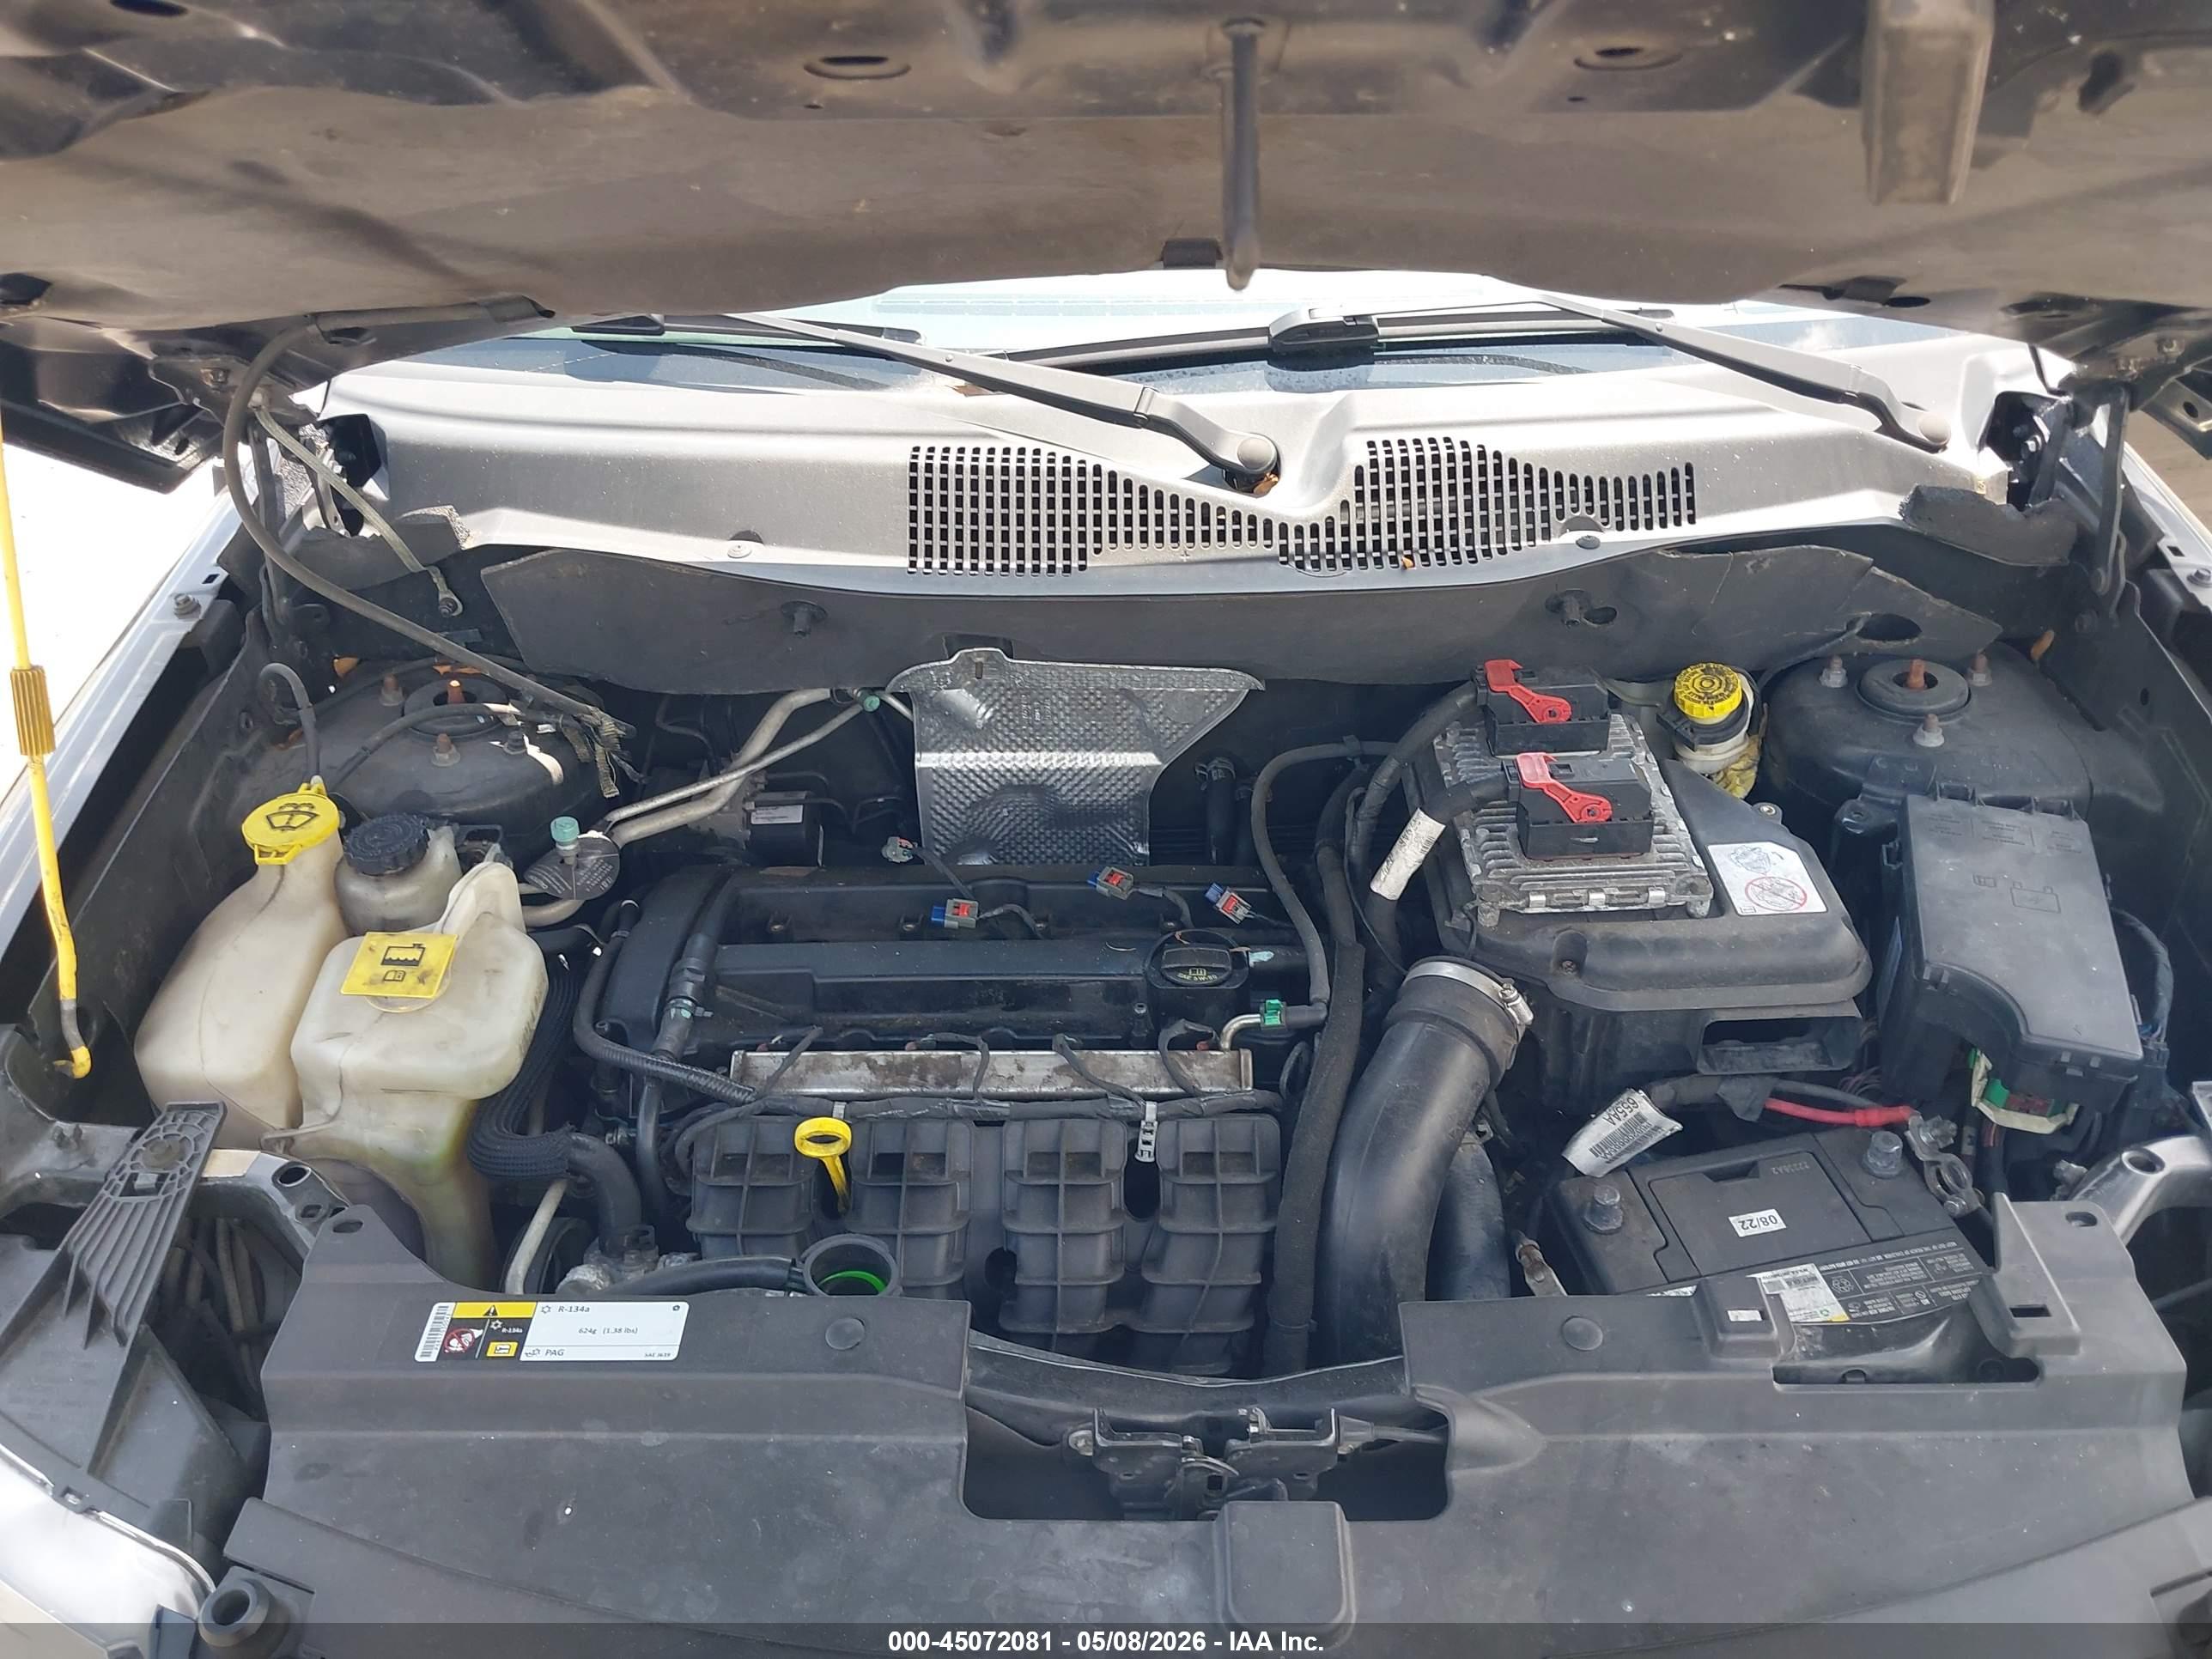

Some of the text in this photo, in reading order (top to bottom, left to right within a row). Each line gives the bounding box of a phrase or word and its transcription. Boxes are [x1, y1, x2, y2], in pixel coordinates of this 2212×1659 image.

[1602, 1097, 1639, 1127] 655AA
[1737, 1214, 1779, 1231] 08/22
[558, 1305, 590, 1314] R-134a
[578, 1328, 597, 1336] 624g
[544, 1348, 565, 1357] PAG
